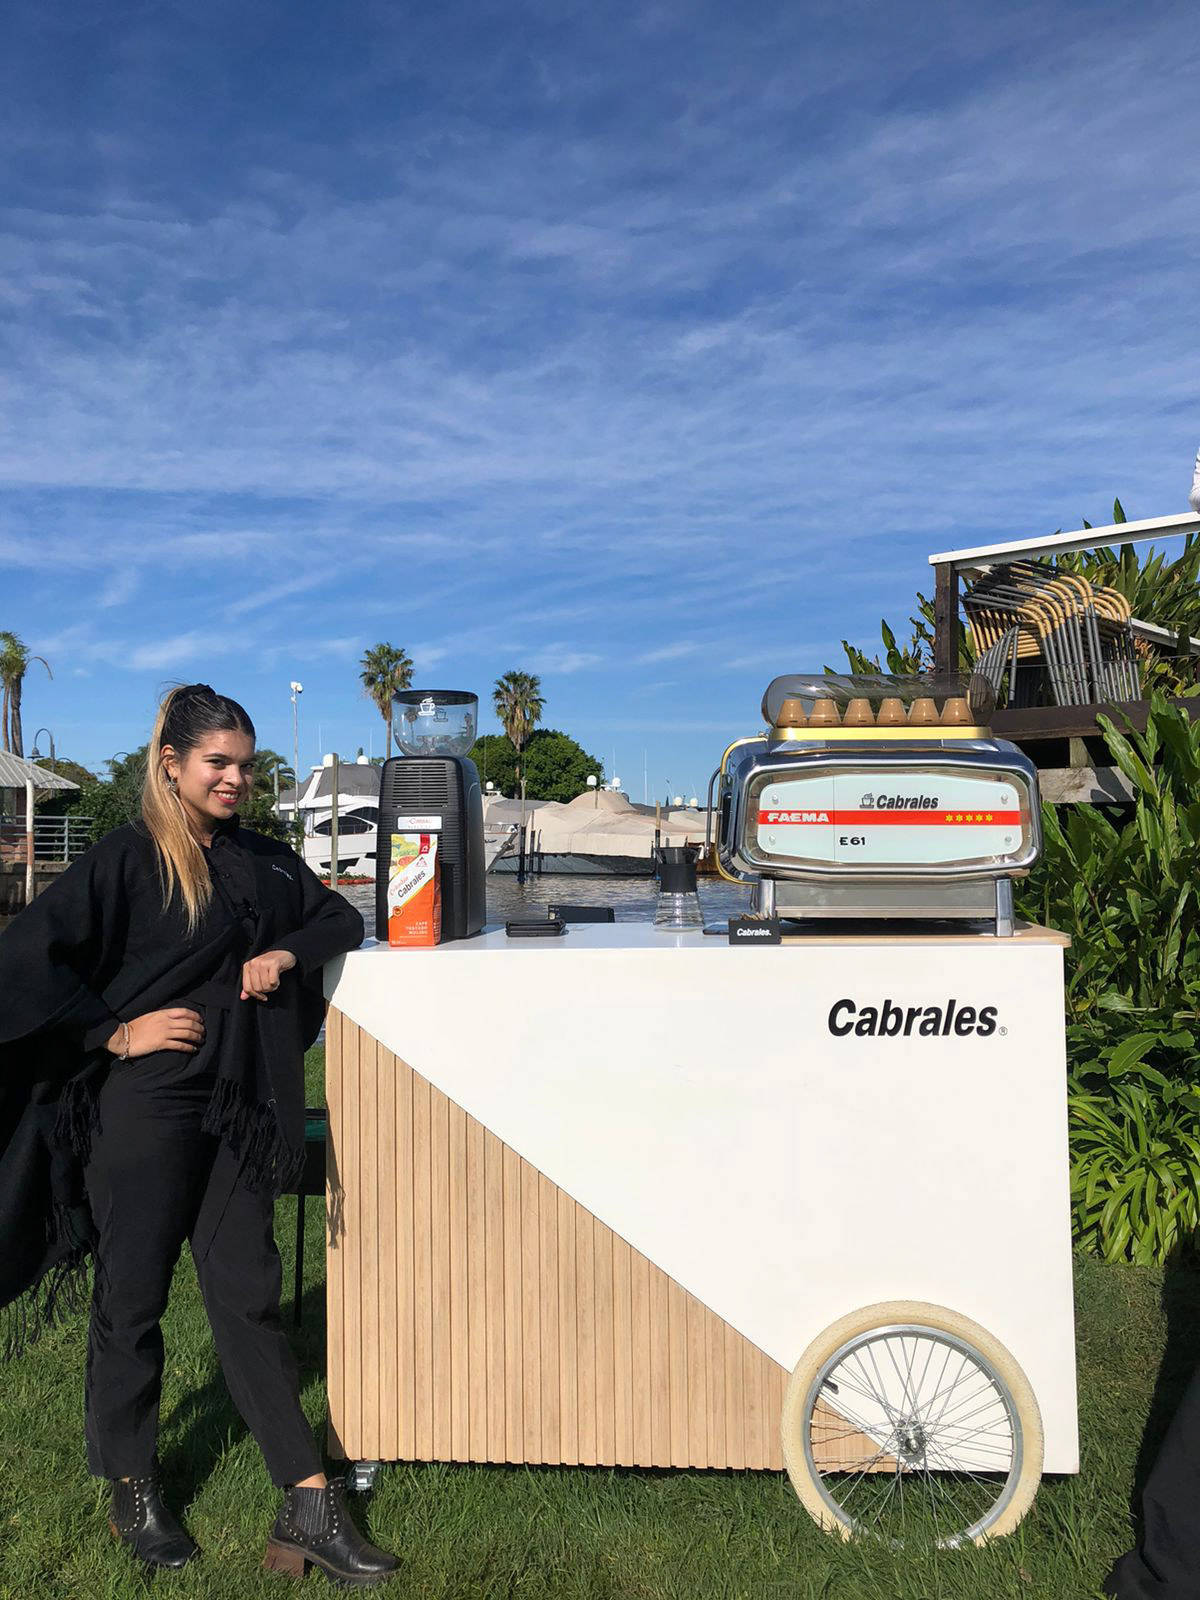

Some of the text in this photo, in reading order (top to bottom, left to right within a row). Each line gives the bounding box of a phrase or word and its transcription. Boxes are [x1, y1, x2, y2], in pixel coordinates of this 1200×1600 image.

[876, 794, 939, 810] Cabrales
[767, 812, 830, 823] FAEMA
[397, 870, 426, 898] Cabrales
[828, 999, 998, 1037] Cabrales
